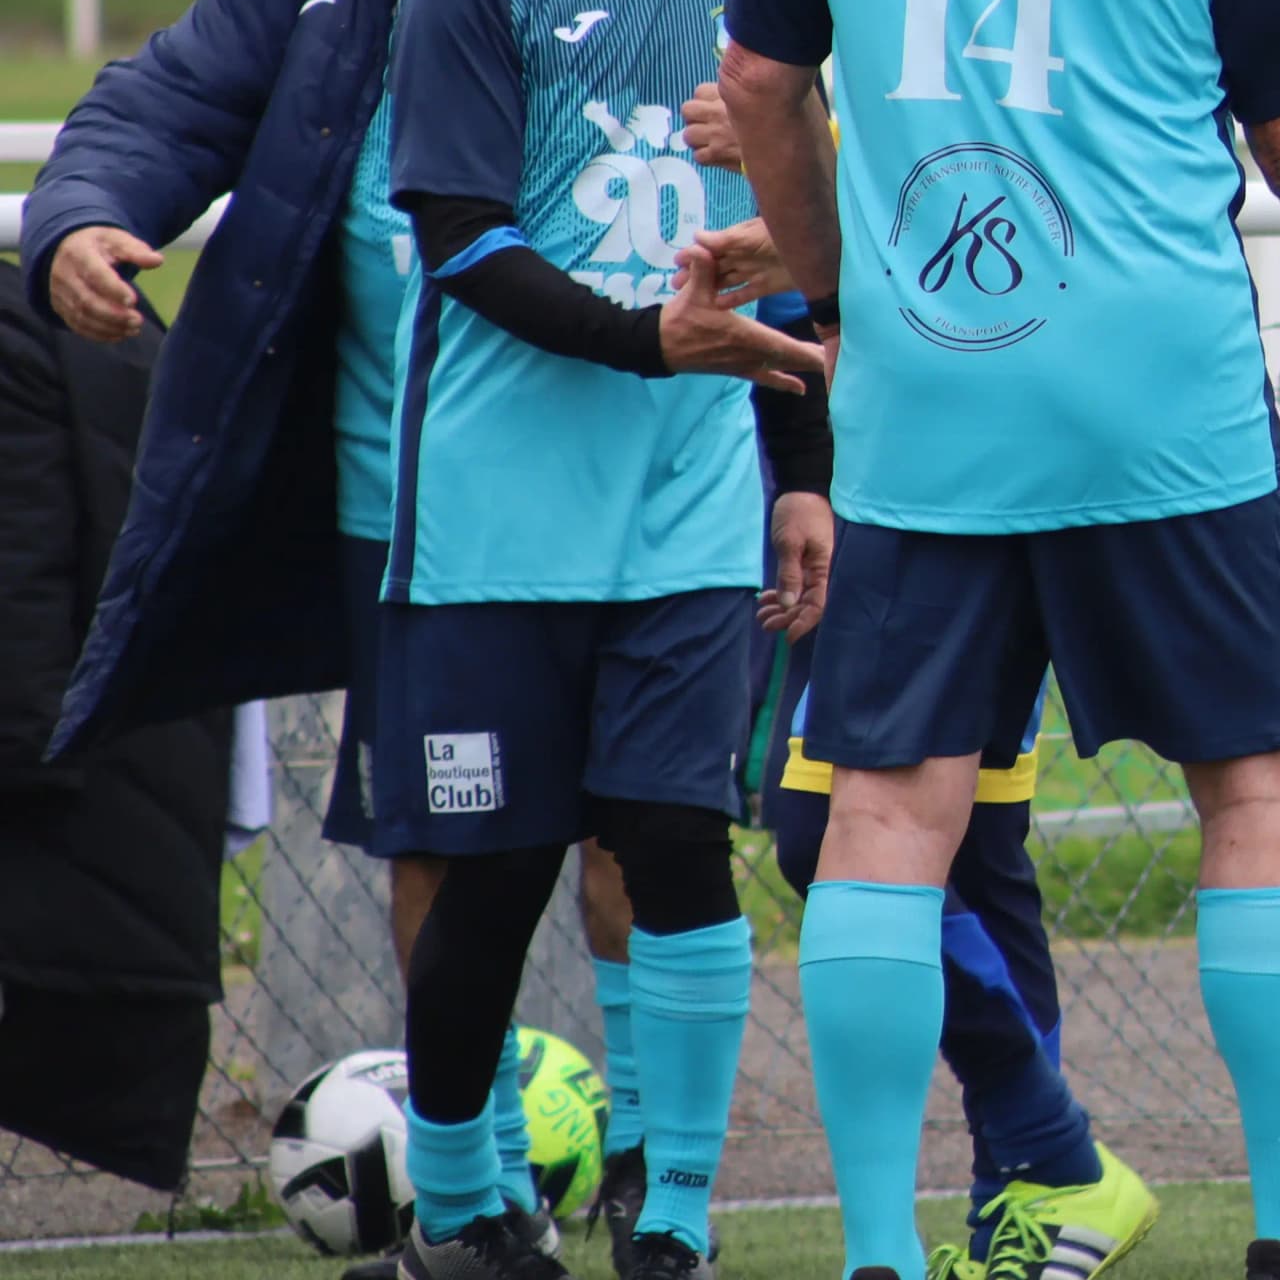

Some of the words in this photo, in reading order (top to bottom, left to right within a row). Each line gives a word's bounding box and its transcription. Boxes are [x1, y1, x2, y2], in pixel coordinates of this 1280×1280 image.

[572, 153, 705, 270] 90
[428, 739, 454, 761] La
[428, 765, 490, 781] boutique
[430, 783, 492, 809] Club
